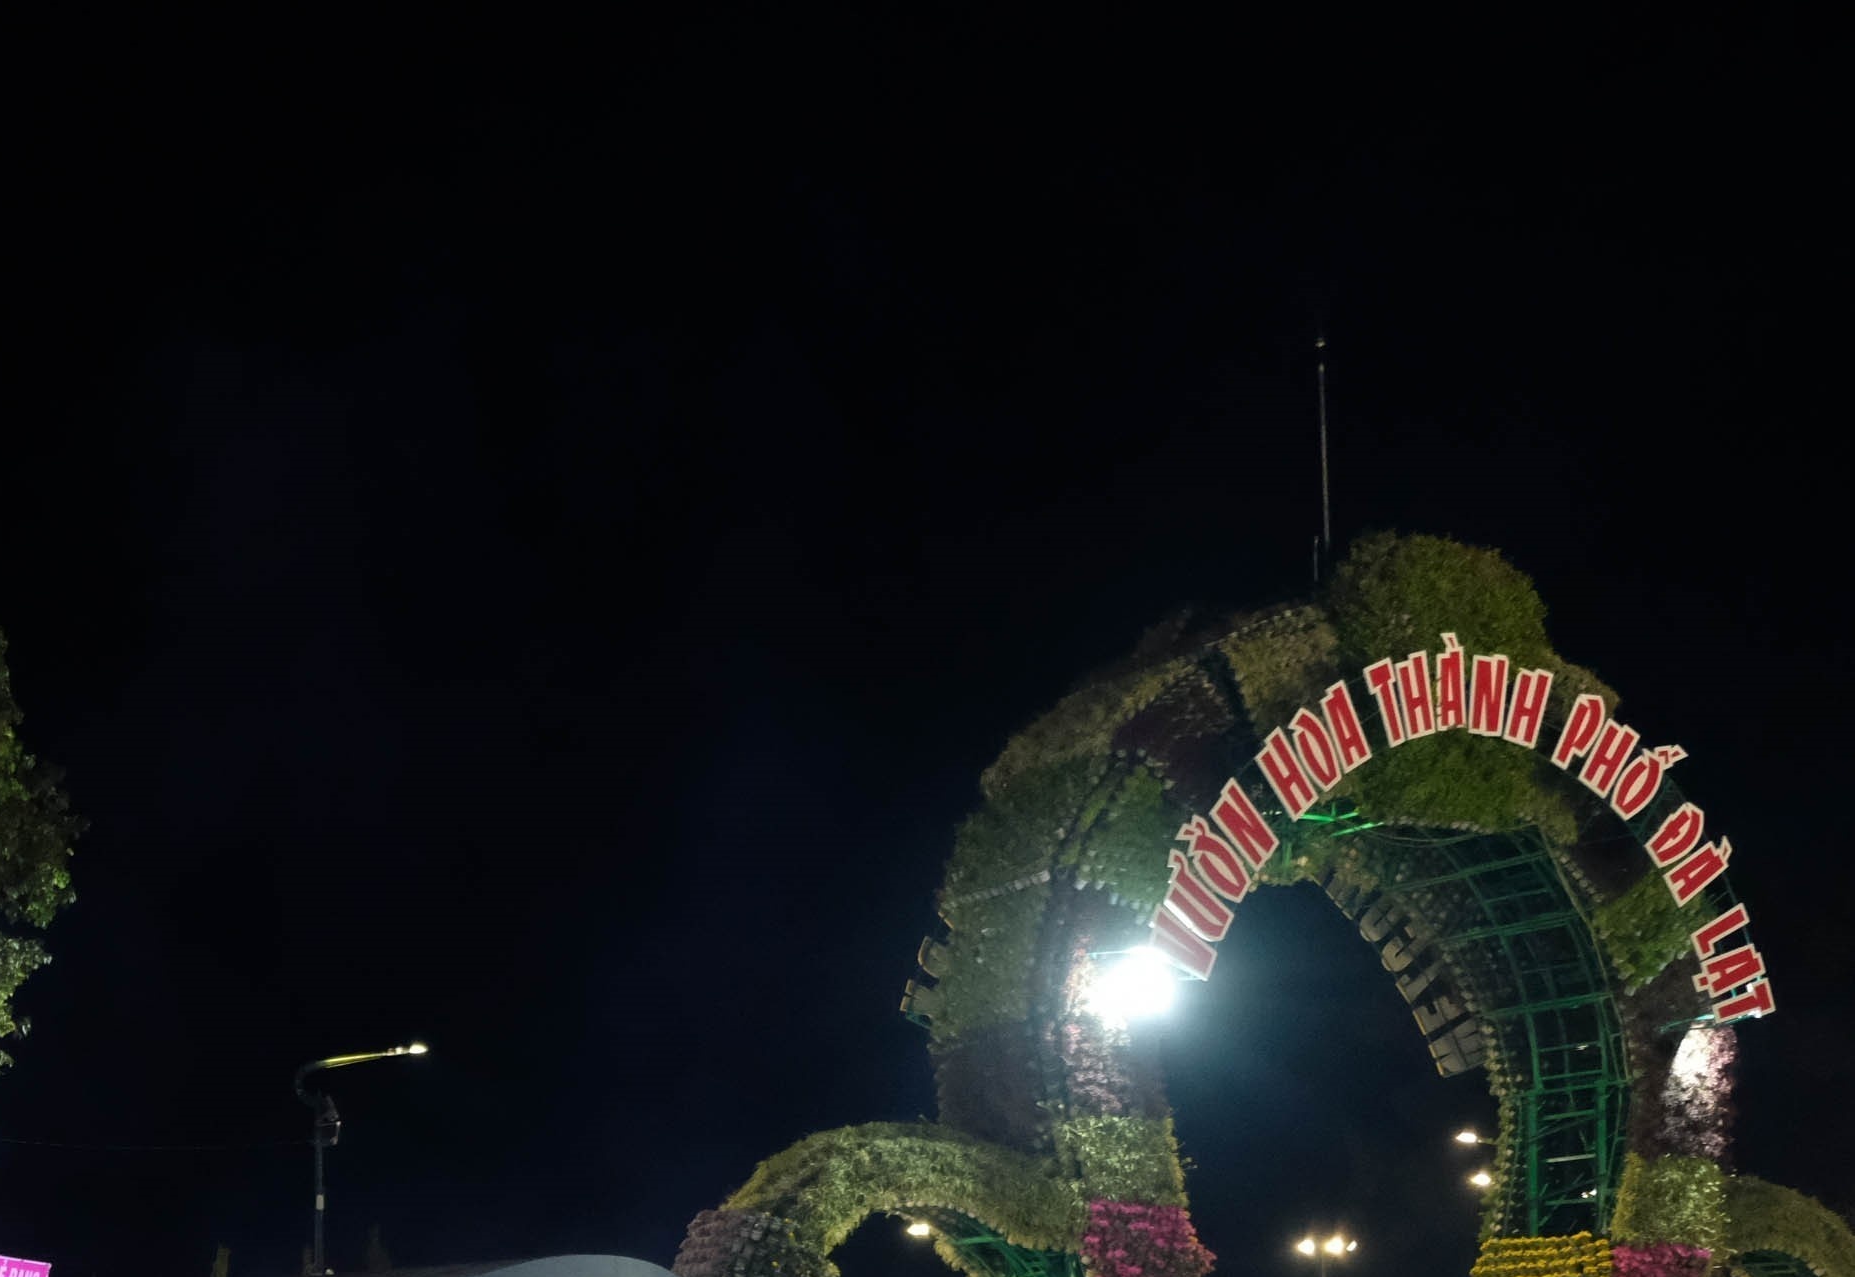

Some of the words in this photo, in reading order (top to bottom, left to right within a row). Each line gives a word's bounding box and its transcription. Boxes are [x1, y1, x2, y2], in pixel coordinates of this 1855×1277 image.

[1146, 777, 1278, 981] VƯỜN
[1255, 680, 1373, 821] HOA
[1364, 633, 1553, 748] THÀNH
[1551, 693, 1688, 820] PHỐ
[1645, 802, 1733, 907] ĐÀ
[1691, 903, 1776, 1023] LẠT
